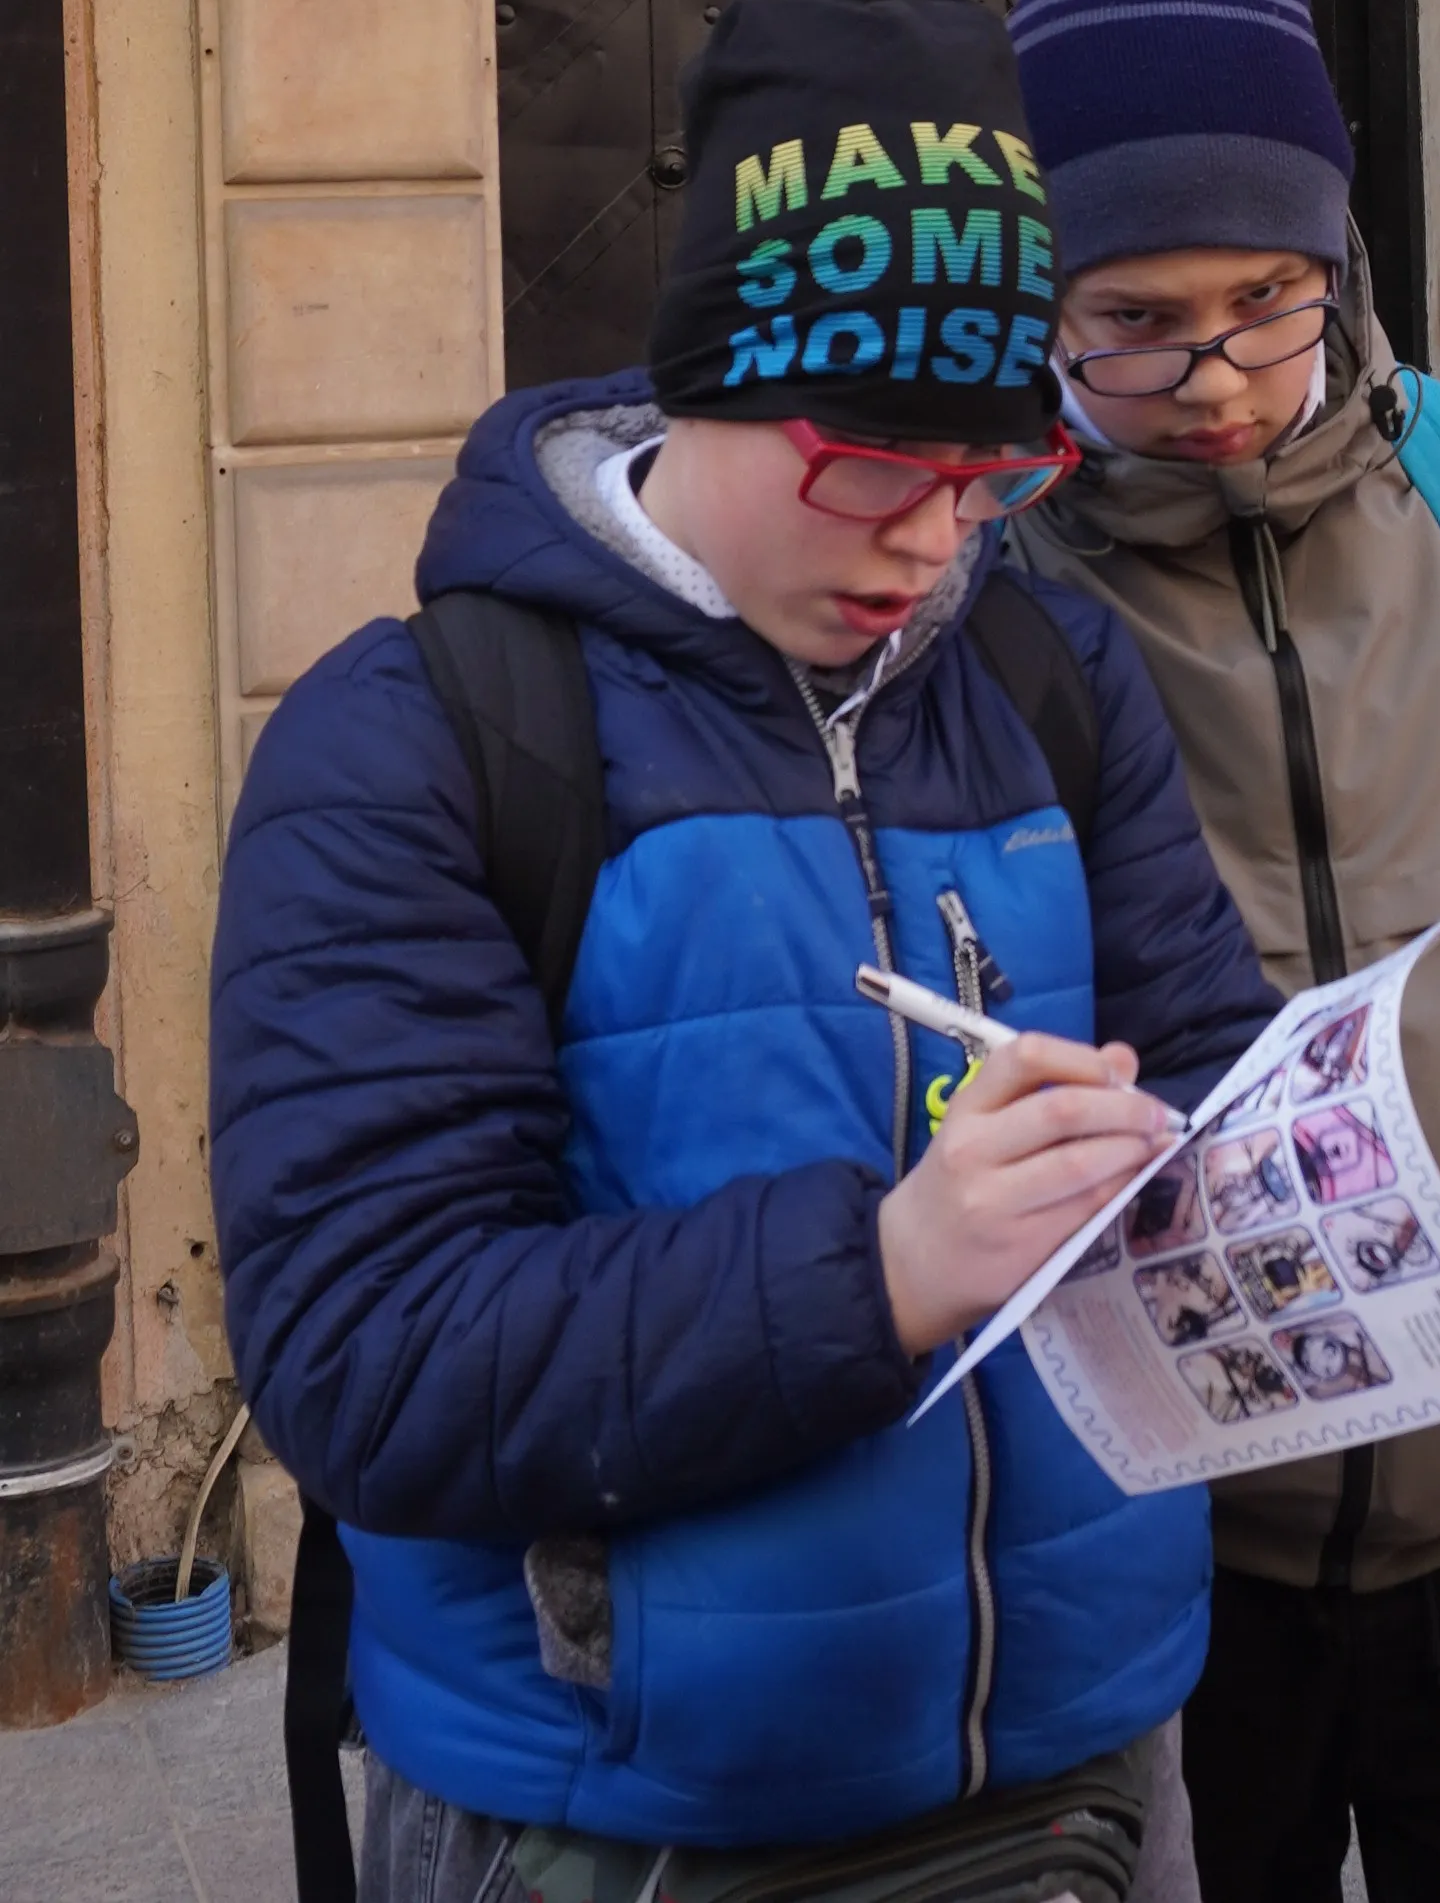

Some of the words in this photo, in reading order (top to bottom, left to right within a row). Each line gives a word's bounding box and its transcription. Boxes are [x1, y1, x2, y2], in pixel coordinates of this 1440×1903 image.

[734, 120, 1048, 234] MAKE
[735, 207, 1056, 308] SOME
[722, 306, 1050, 388] NOISE
